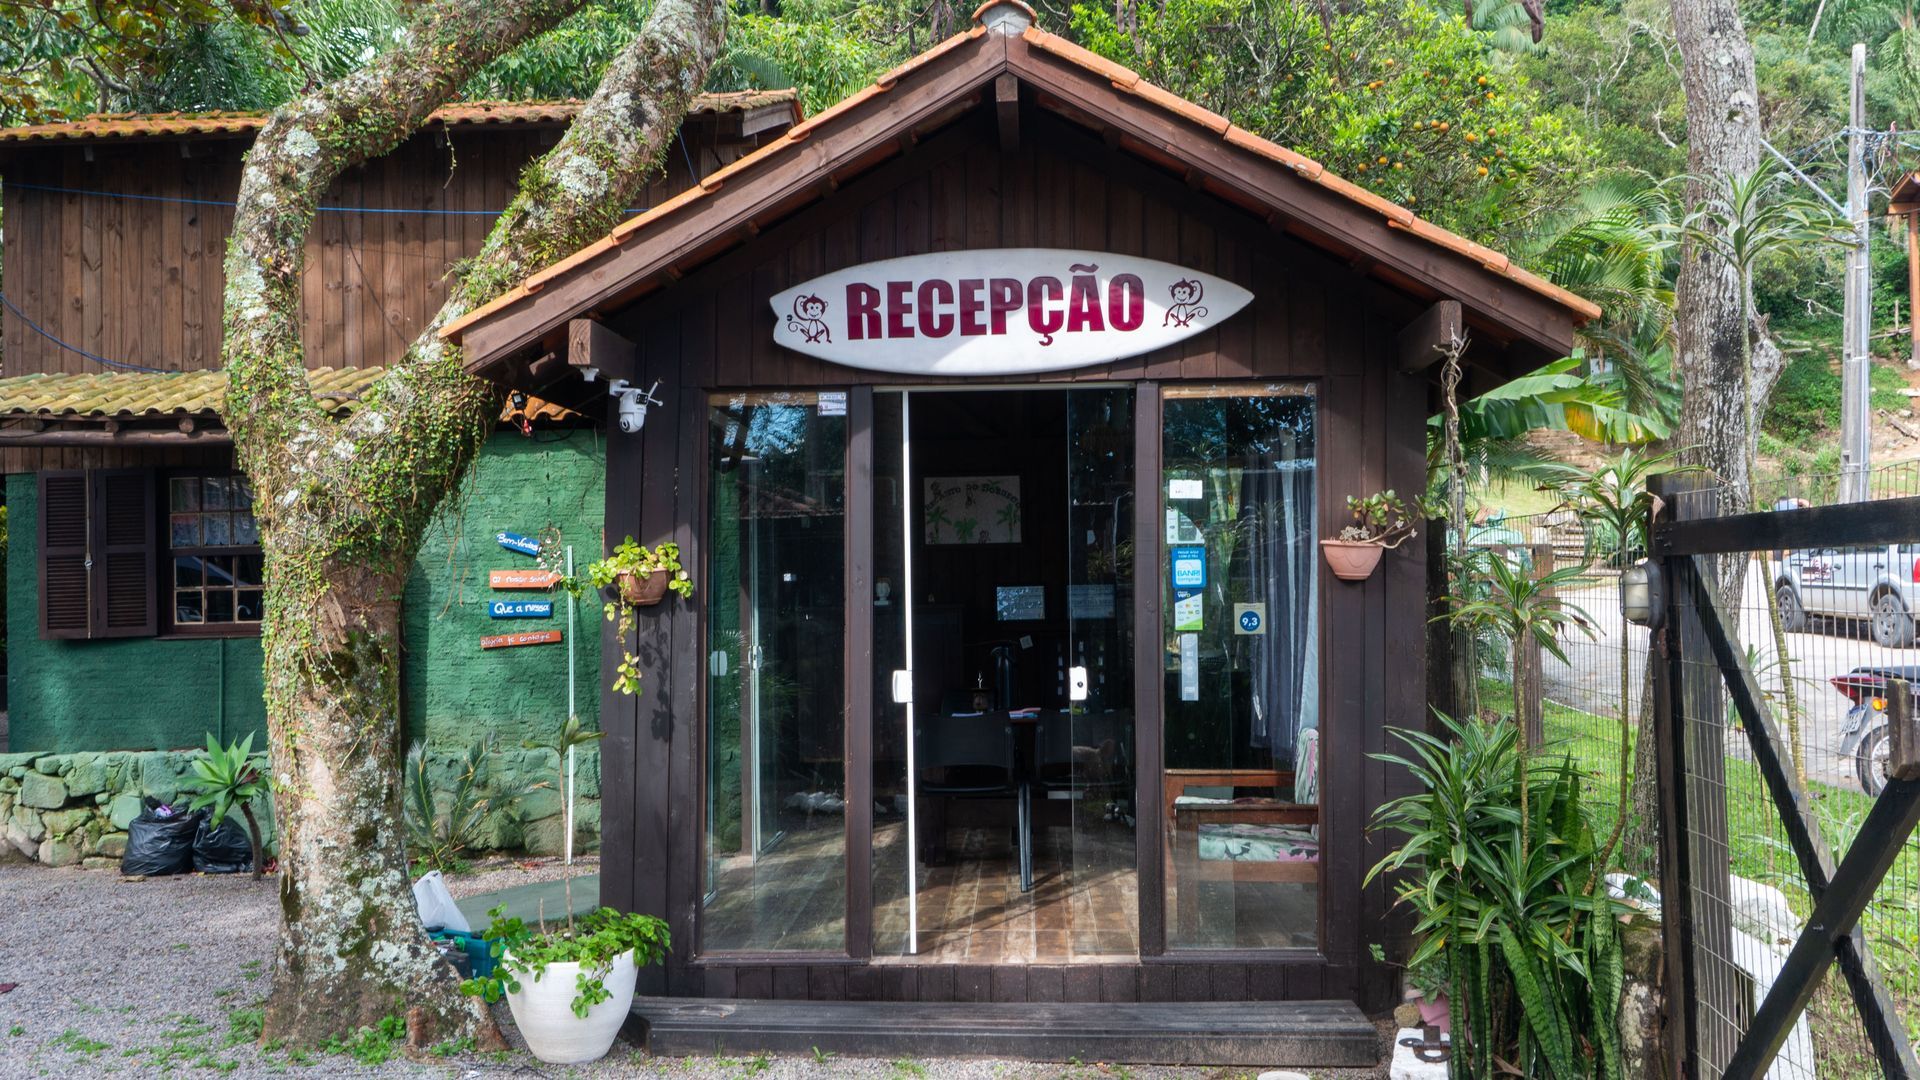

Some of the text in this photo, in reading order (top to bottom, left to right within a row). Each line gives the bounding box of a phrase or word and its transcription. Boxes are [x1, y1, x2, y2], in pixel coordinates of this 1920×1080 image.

[845, 263, 1145, 346] RECEPÇÃO
[494, 602, 550, 614] Que a nossa
[1242, 616, 1258, 627] 9,3
